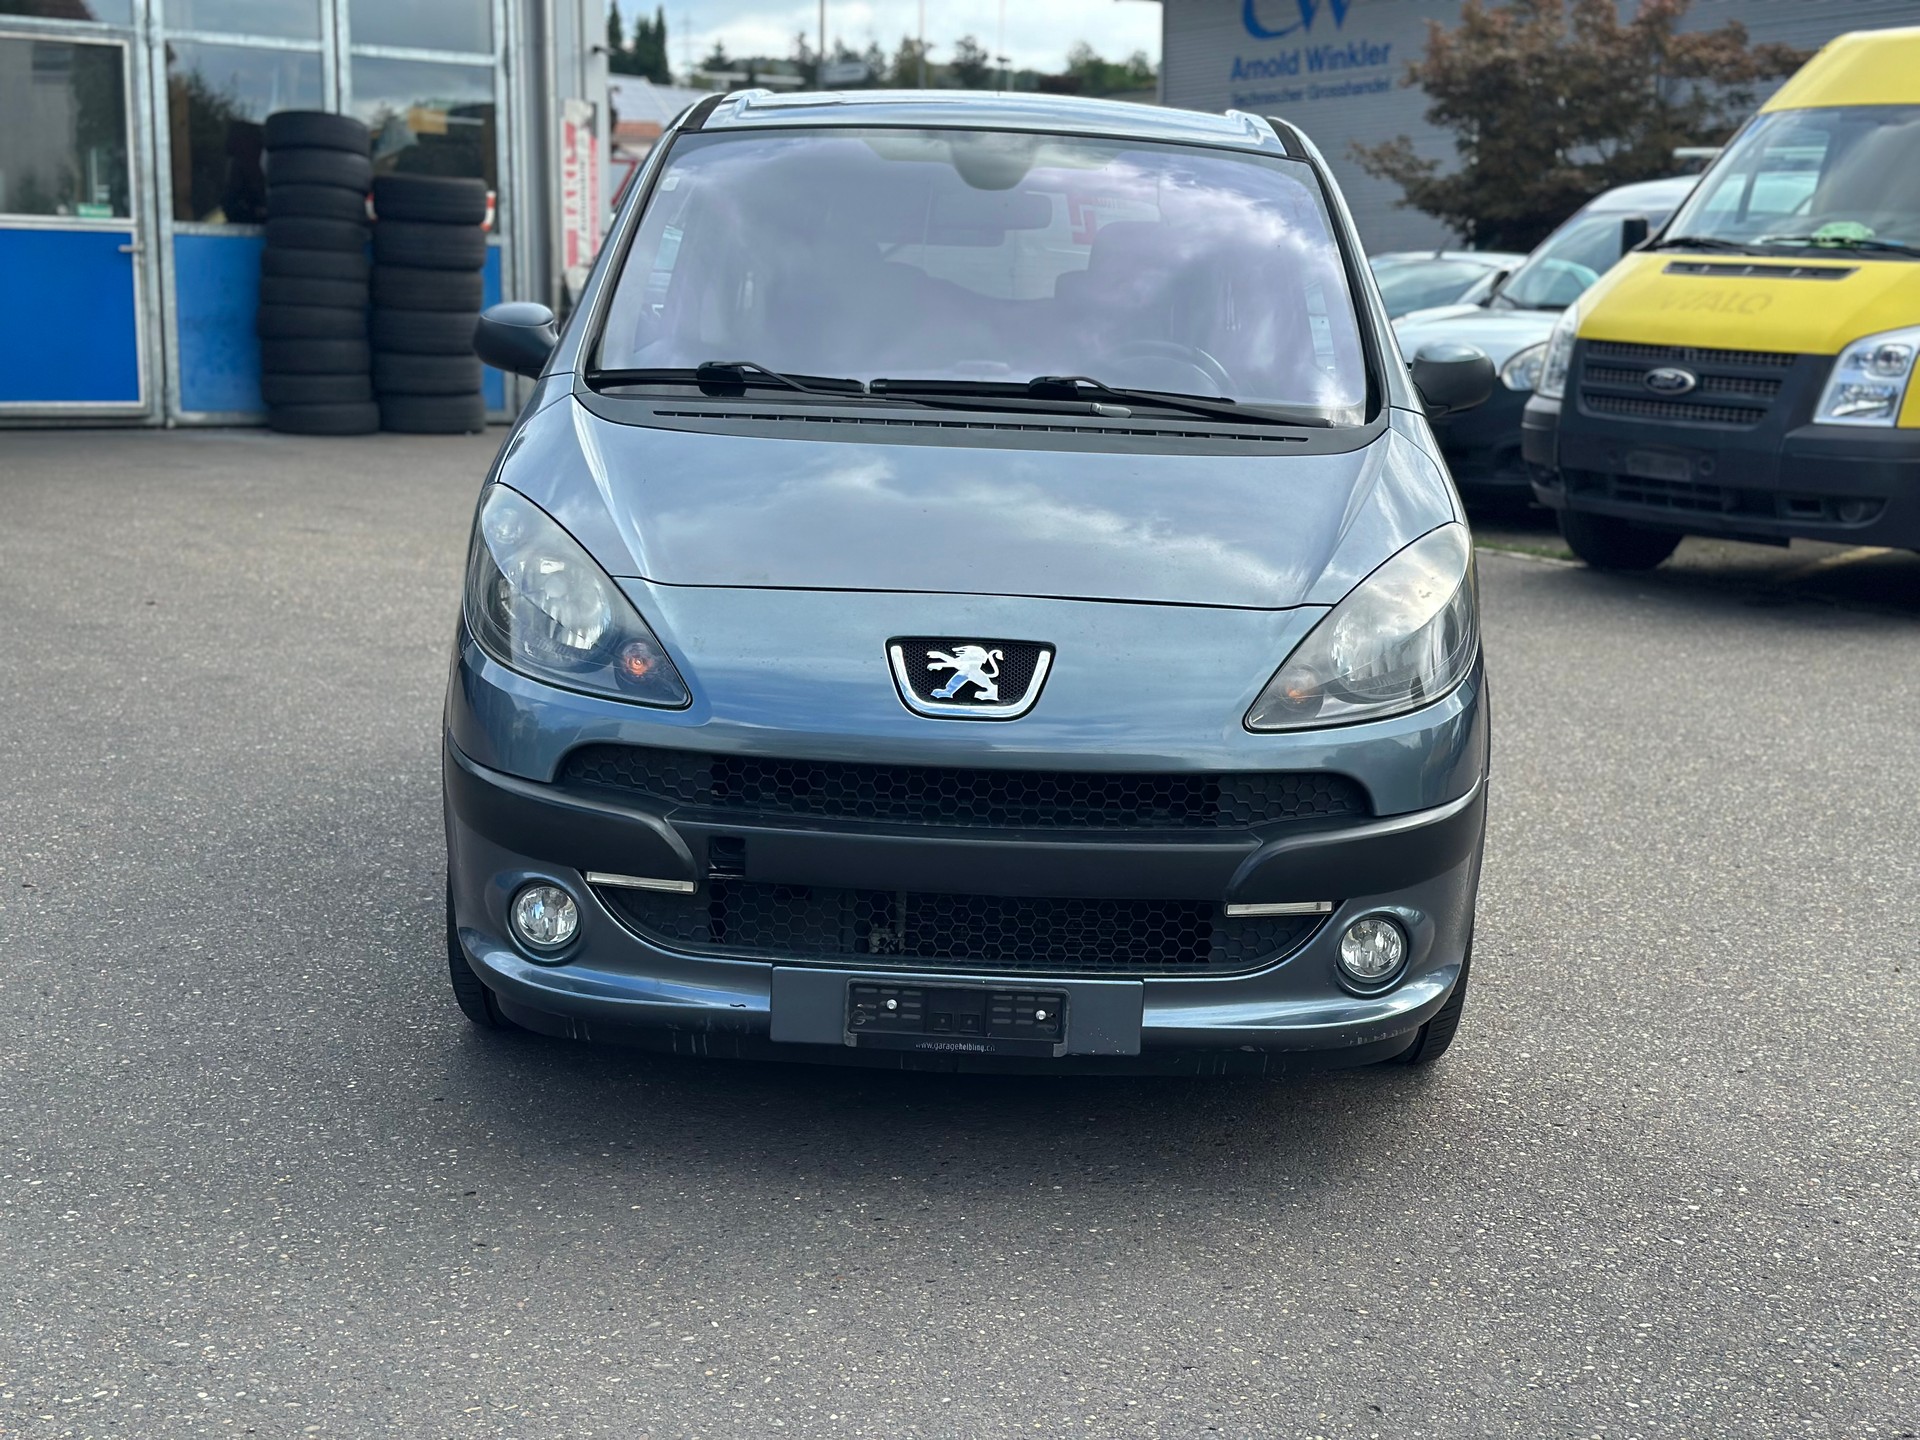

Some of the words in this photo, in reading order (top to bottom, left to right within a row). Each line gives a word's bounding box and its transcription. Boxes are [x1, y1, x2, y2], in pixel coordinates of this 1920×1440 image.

[1230, 49, 1299, 81] Arnold
[1306, 41, 1391, 73] Winkler
[1660, 290, 1773, 315] WALO
